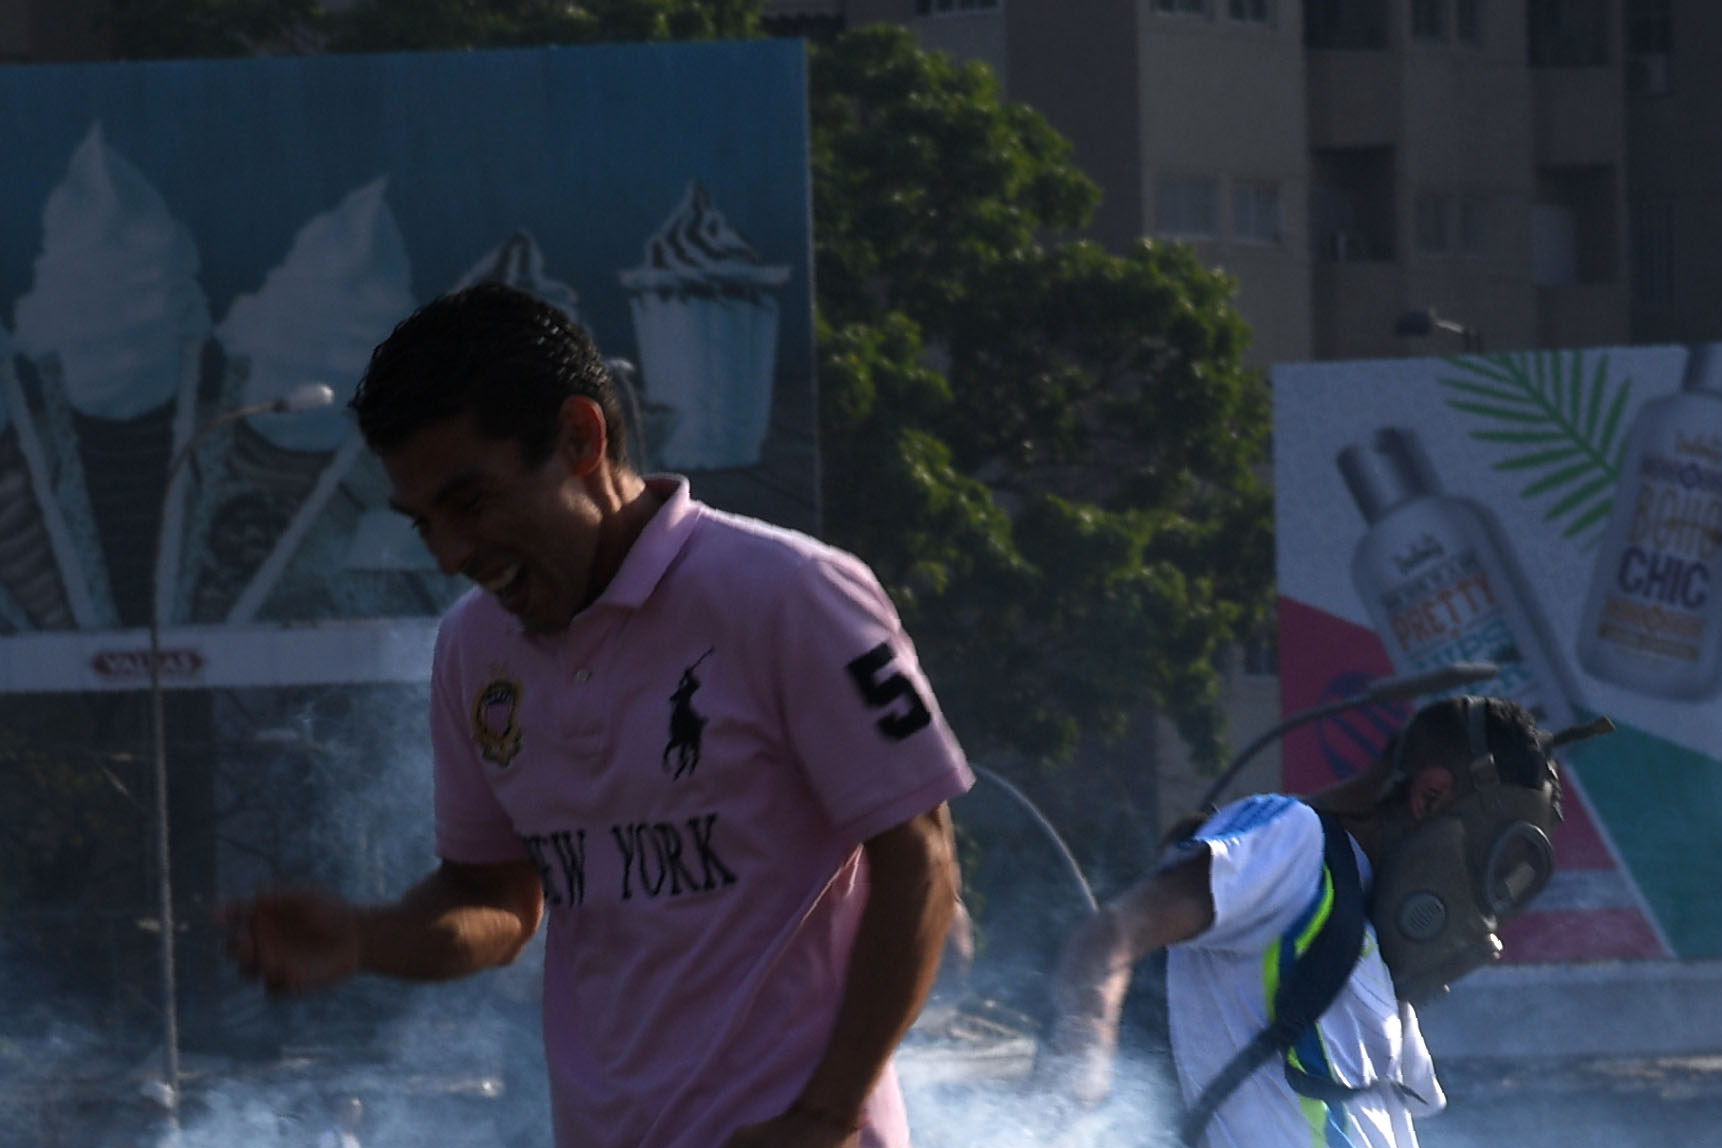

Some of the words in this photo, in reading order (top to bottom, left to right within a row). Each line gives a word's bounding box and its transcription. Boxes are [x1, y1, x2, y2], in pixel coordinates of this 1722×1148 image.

[1389, 570, 1498, 653] PRETTY
[1617, 546, 1710, 609] CHIC
[845, 641, 932, 742] 5
[521, 828, 586, 906] EW
[611, 812, 738, 900] YORK
